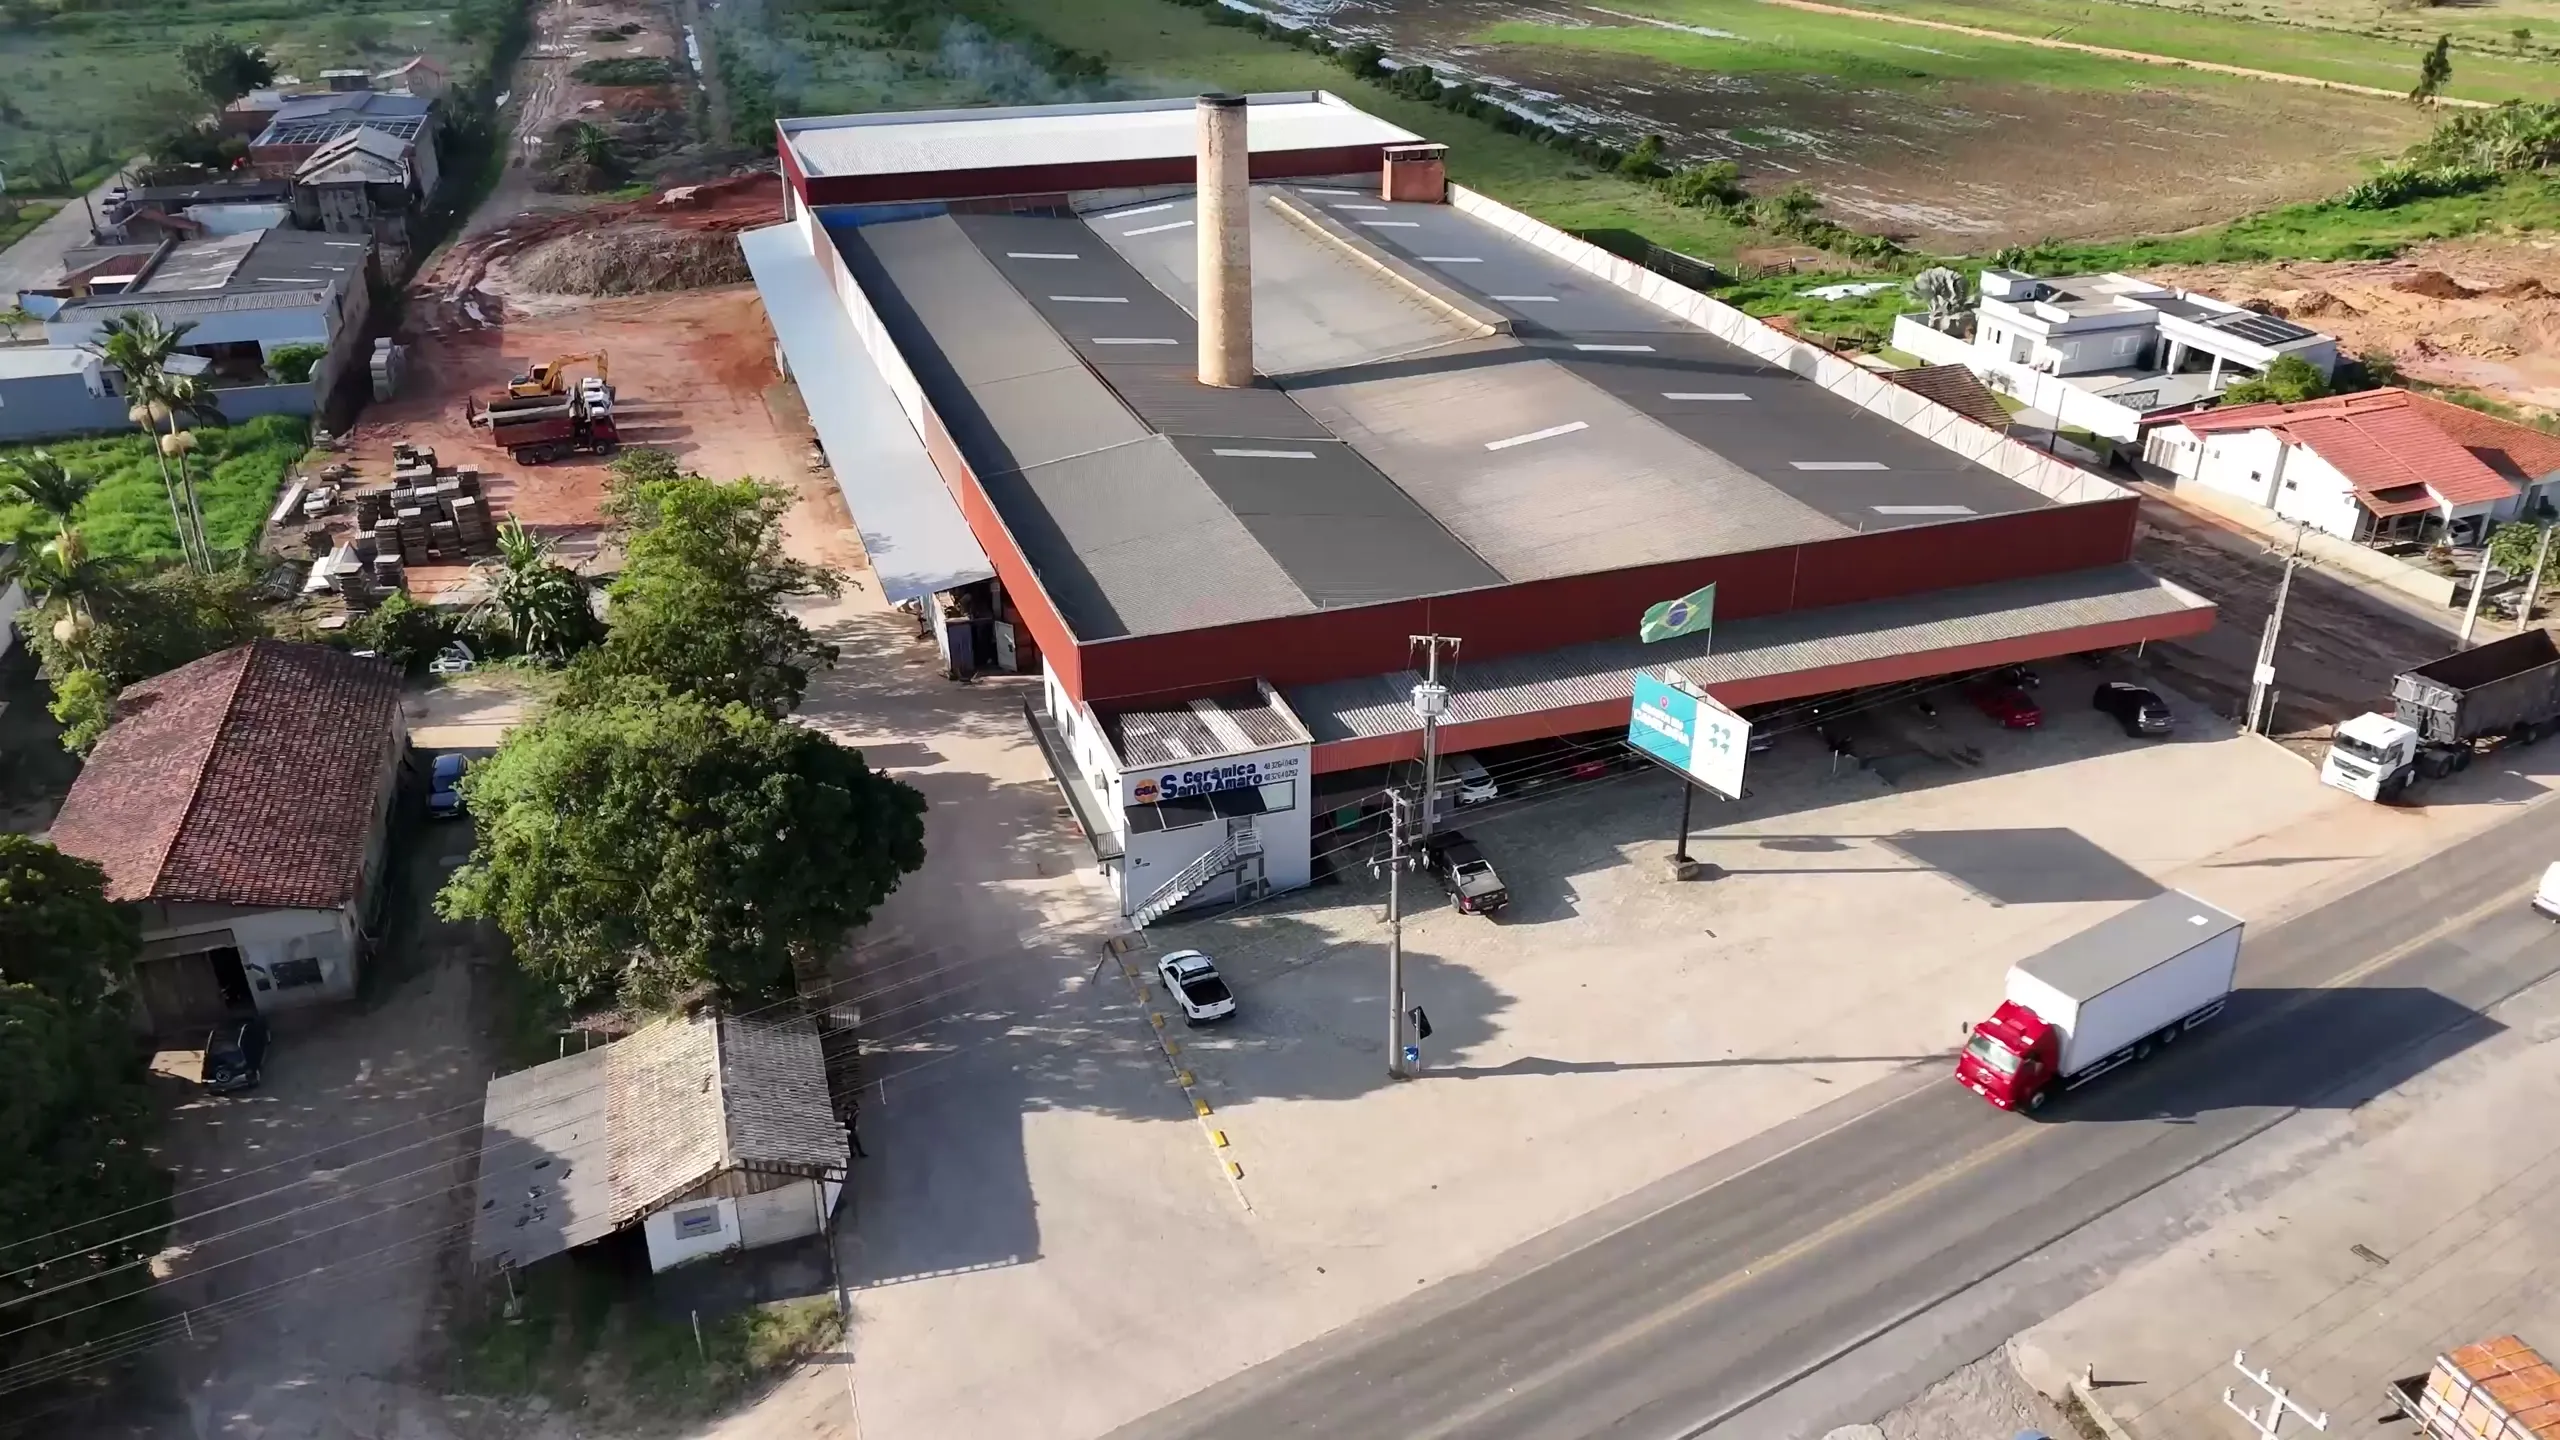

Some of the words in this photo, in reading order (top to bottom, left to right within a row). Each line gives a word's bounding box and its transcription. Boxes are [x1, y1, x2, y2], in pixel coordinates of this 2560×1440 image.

[1184, 763, 1256, 784] Cerâmica
[1160, 774, 1213, 798] Santo
[1214, 773, 1263, 791] Amaro
